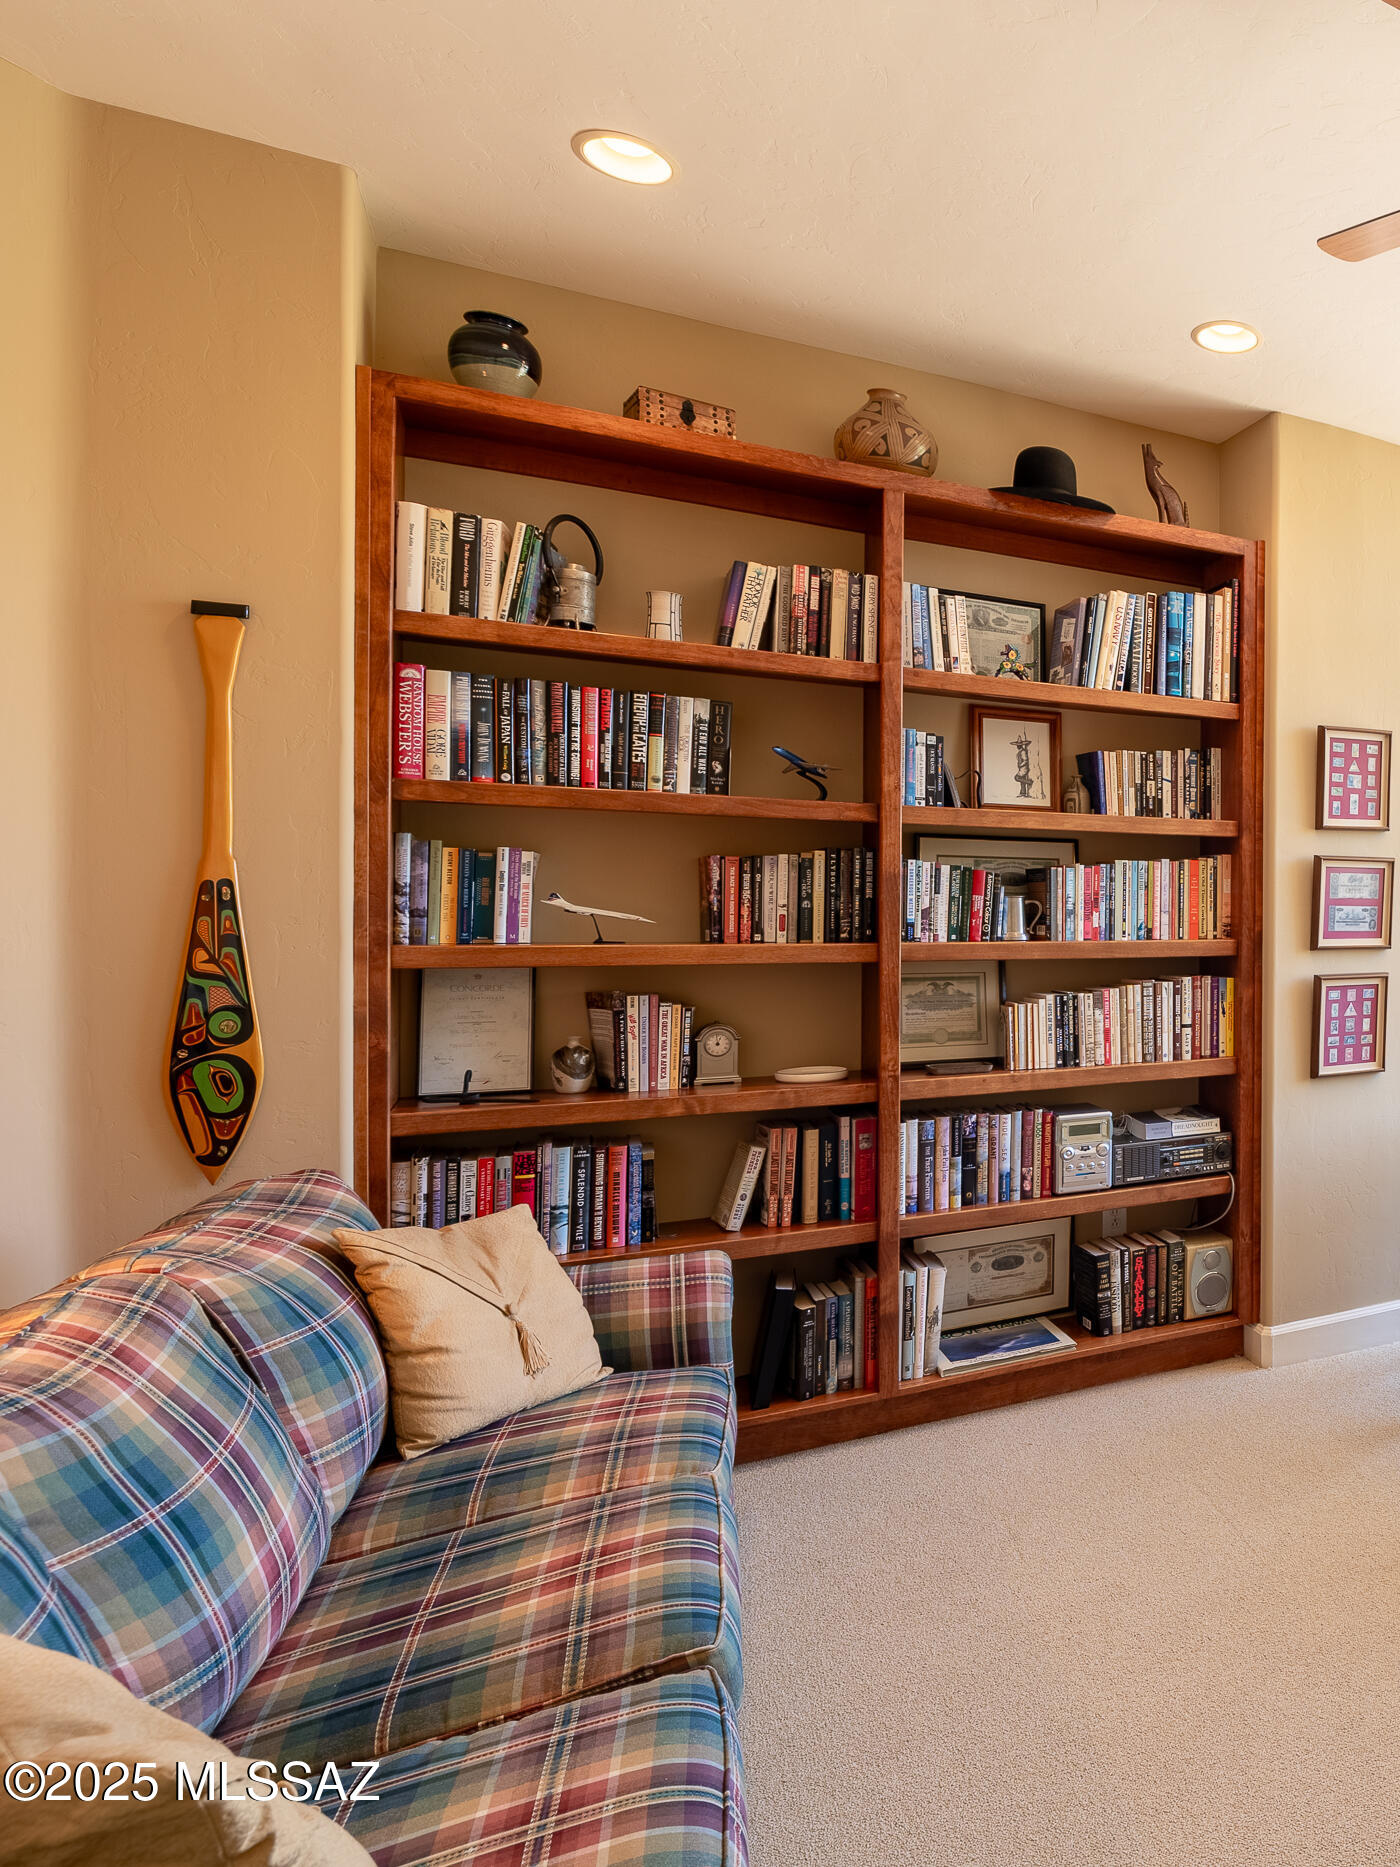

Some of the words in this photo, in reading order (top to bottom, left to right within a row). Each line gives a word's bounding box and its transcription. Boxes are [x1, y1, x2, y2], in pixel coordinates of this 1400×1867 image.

[430, 518, 440, 554] Relations
[459, 517, 476, 541] FORD
[439, 533, 450, 555] Blood
[482, 522, 498, 587] Guggenheims
[747, 576, 756, 592] THY
[750, 578, 764, 608] HONOR
[851, 584, 860, 595] WILD
[740, 592, 754, 621] FATHER
[1112, 623, 1121, 646] NAVY
[1132, 616, 1142, 662] HAWAII
[1118, 638, 1128, 674] AMERICA
[413, 681, 422, 727] RANDOM
[551, 682, 563, 706] PATRICIA
[572, 690, 580, 724] INVASION!
[399, 680, 412, 764] WEBSTER'S
[428, 694, 447, 724] EMPIRE
[551, 706, 563, 732] CORNWELL
[601, 689, 611, 730] CITADEL
[633, 694, 648, 725] ENEMY
[478, 722, 492, 736] JOHN
[500, 716, 511, 744] JAPAN
[571, 726, 580, 750] THEY'RE
[698, 732, 708, 743] END
[714, 706, 724, 744] HERO
[413, 730, 422, 766] HOUSE
[427, 729, 436, 757] VIDAL
[436, 729, 447, 758] GORE
[478, 738, 492, 762] DUNNING
[632, 734, 646, 763] GATES
[698, 746, 707, 756] ALL
[571, 752, 580, 780] COMING!
[698, 759, 706, 774] WARS
[521, 892, 530, 908] MARCH
[520, 915, 528, 928] FOLLY
[450, 984, 505, 993] CONCORDE
[628, 1026, 638, 1040] Rogers
[1174, 1122, 1214, 1130] DREADNOUGHT
[433, 1162, 441, 1177] PHILIP
[595, 1154, 604, 1185] SURVIVING
[746, 1150, 757, 1174] THUNDER
[770, 1156, 779, 1168] LAST
[784, 1156, 794, 1168] LAST
[448, 1170, 457, 1202] LENINGRAD'S
[465, 1174, 476, 1188] Tom
[577, 1169, 586, 1206] SPLENDID
[612, 1172, 620, 1202] MIRACLE
[770, 1170, 778, 1196] OUTLAWS
[784, 1170, 793, 1196] OUTLAWS
[924, 1173, 932, 1200] FRONTIER
[464, 1190, 476, 1212] Clancy
[595, 1186, 603, 1210] BATAAN
[448, 1204, 456, 1220] GATES
[594, 1217, 602, 1240] BEYOND
[904, 1312, 912, 1340] Illustrated
